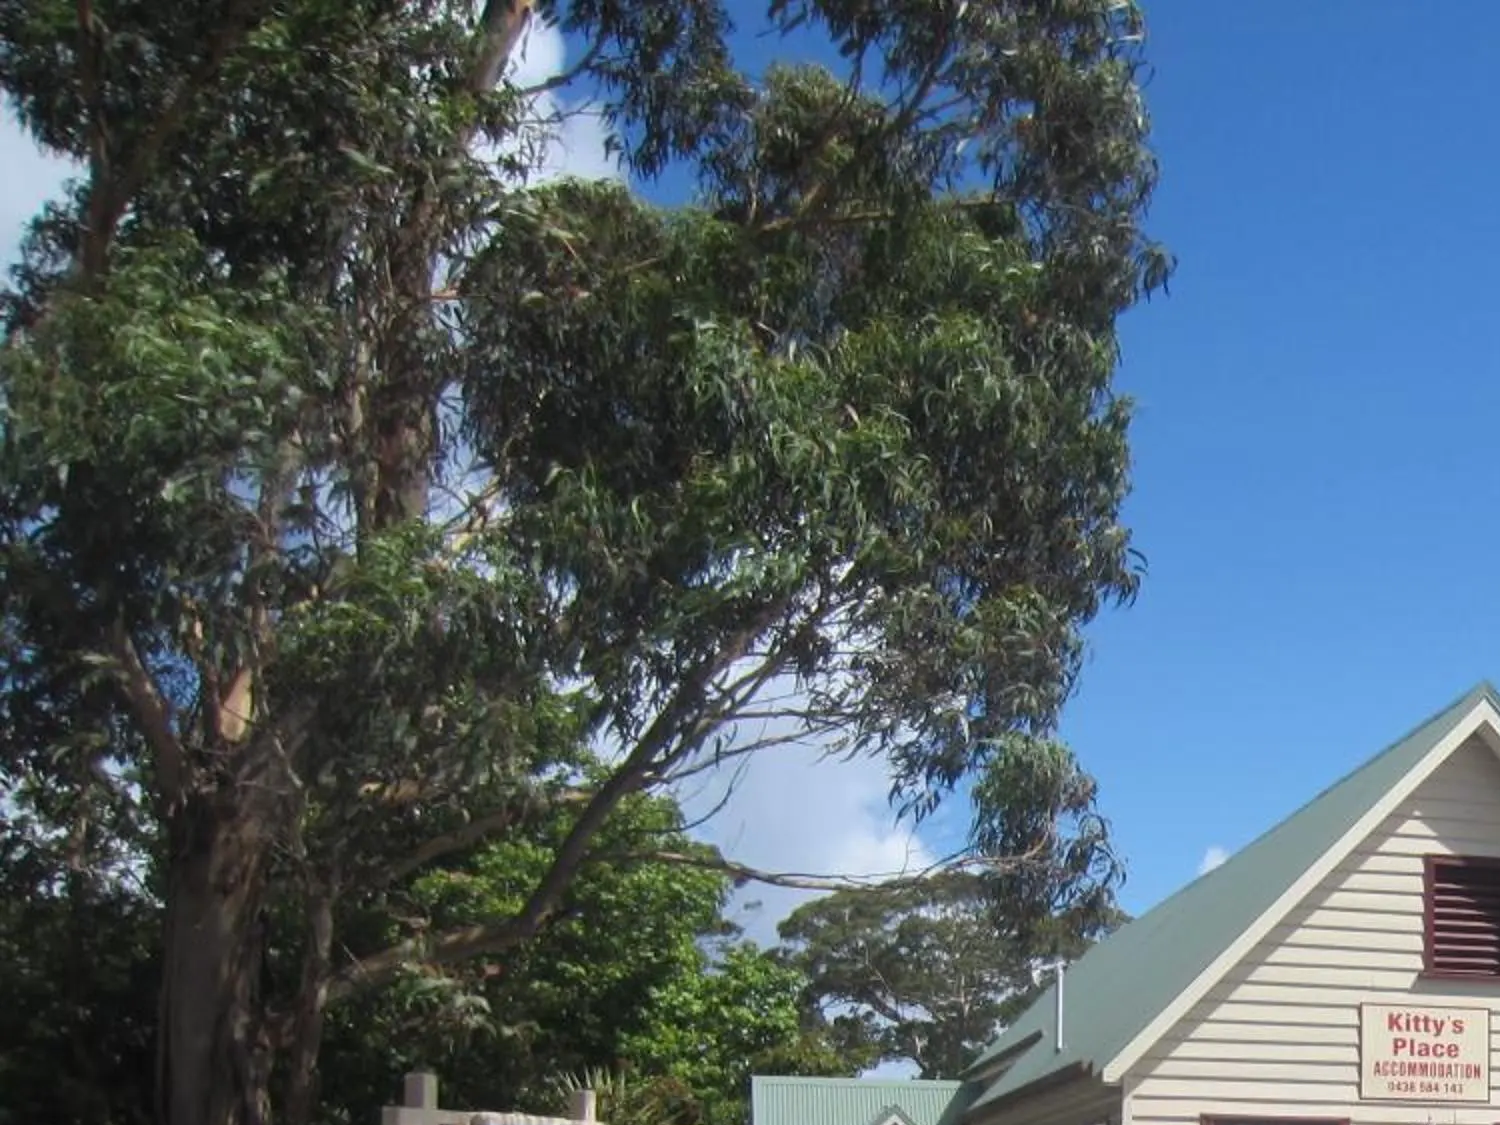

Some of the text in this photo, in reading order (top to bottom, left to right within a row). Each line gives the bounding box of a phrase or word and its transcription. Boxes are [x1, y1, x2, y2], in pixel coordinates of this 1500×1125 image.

[1387, 1012, 1465, 1036] Kitty's
[1392, 1037, 1460, 1058] Place
[1373, 1061, 1481, 1079] ACCOMMODATION
